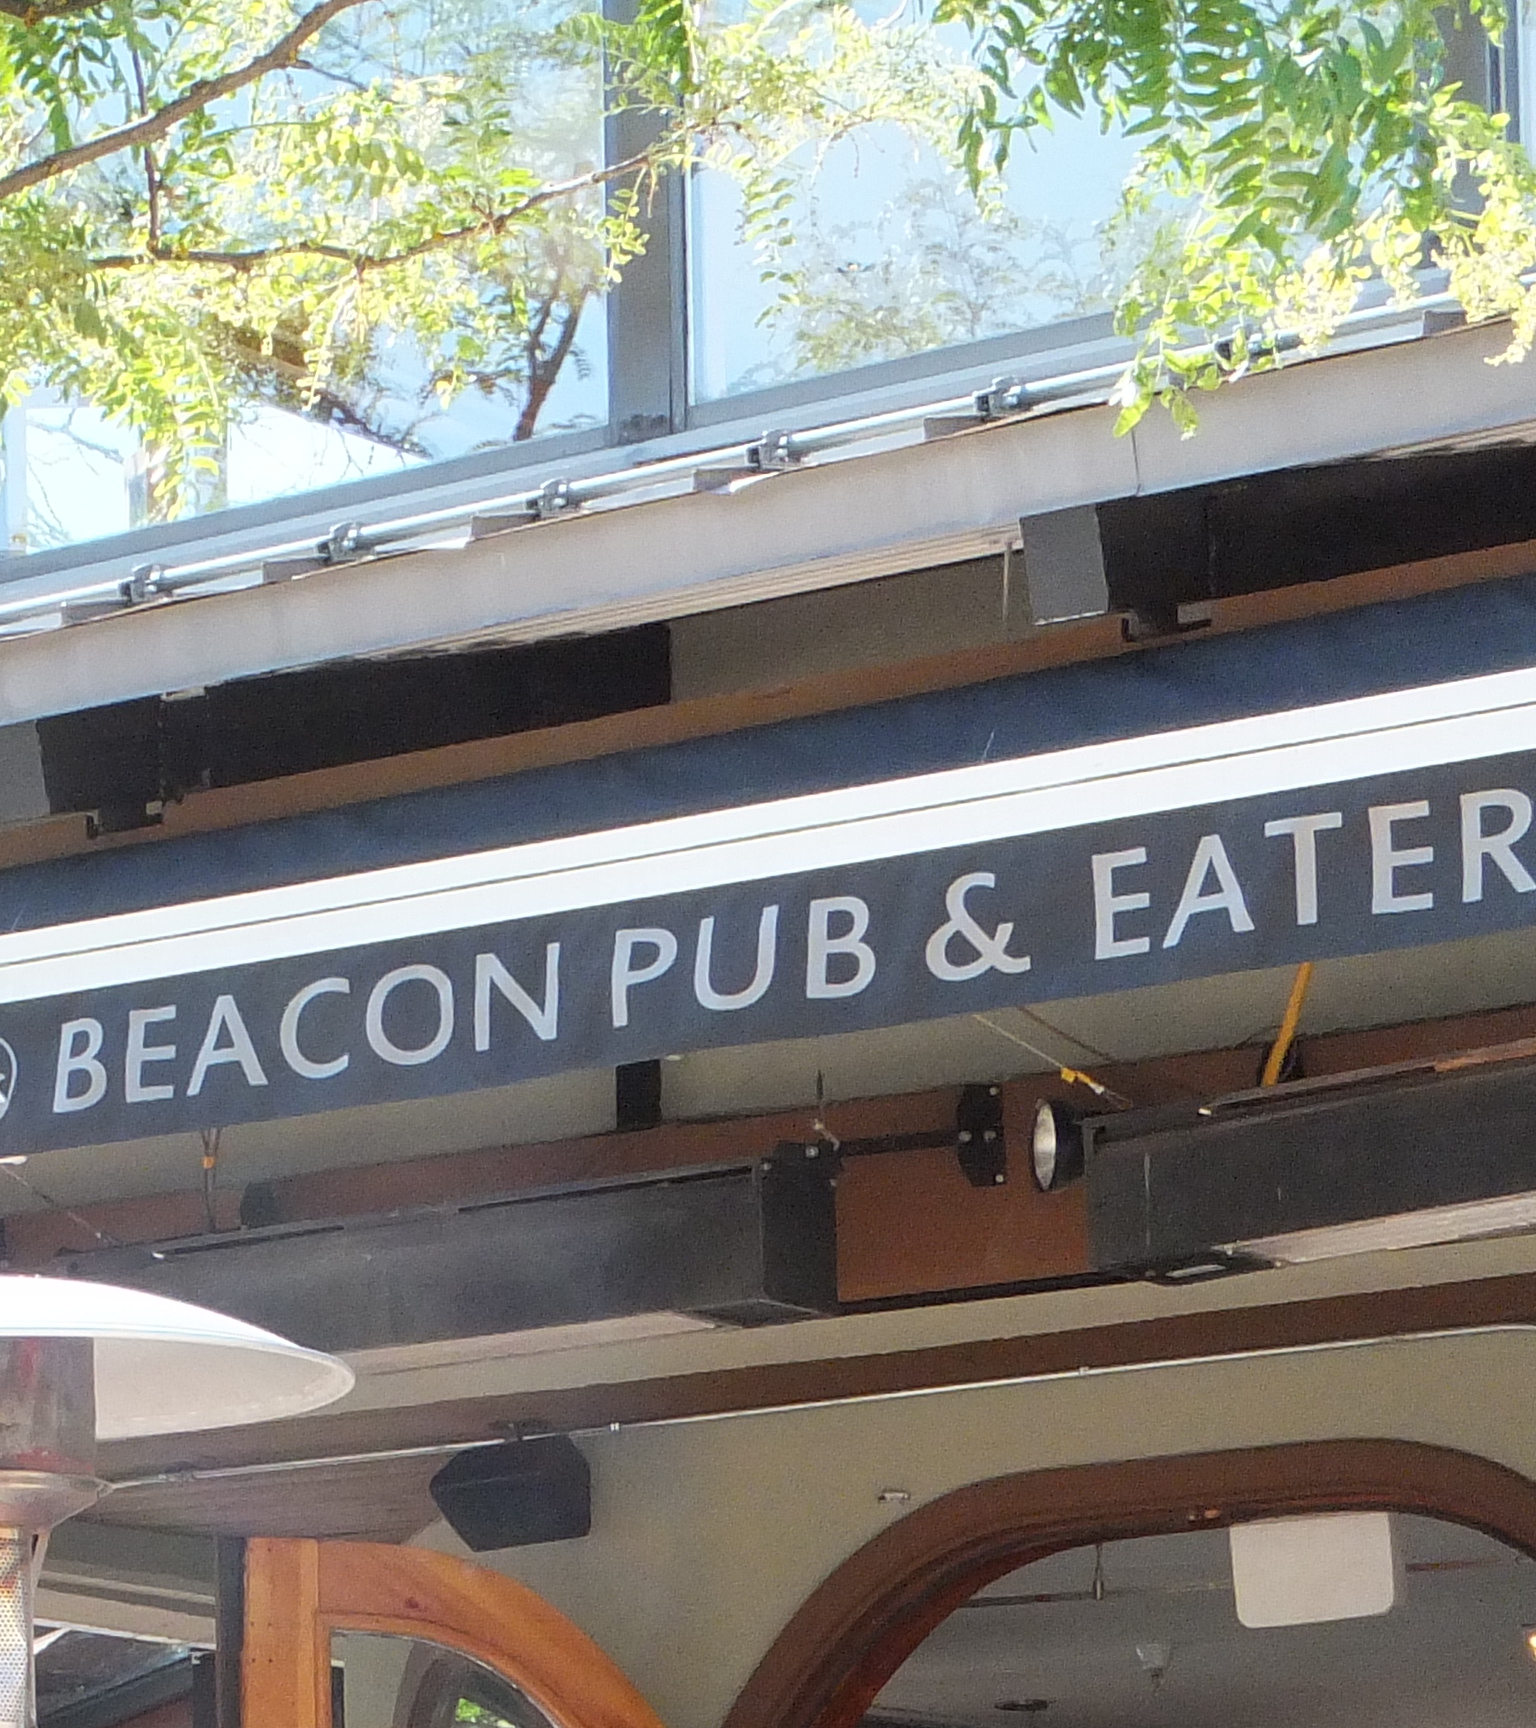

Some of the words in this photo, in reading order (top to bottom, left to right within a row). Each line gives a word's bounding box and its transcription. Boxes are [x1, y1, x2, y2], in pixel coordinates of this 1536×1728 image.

[51, 940, 562, 1115] BEACON
[609, 894, 877, 1030] PUB
[924, 870, 1033, 983] &
[1090, 787, 1536, 962] EATER
